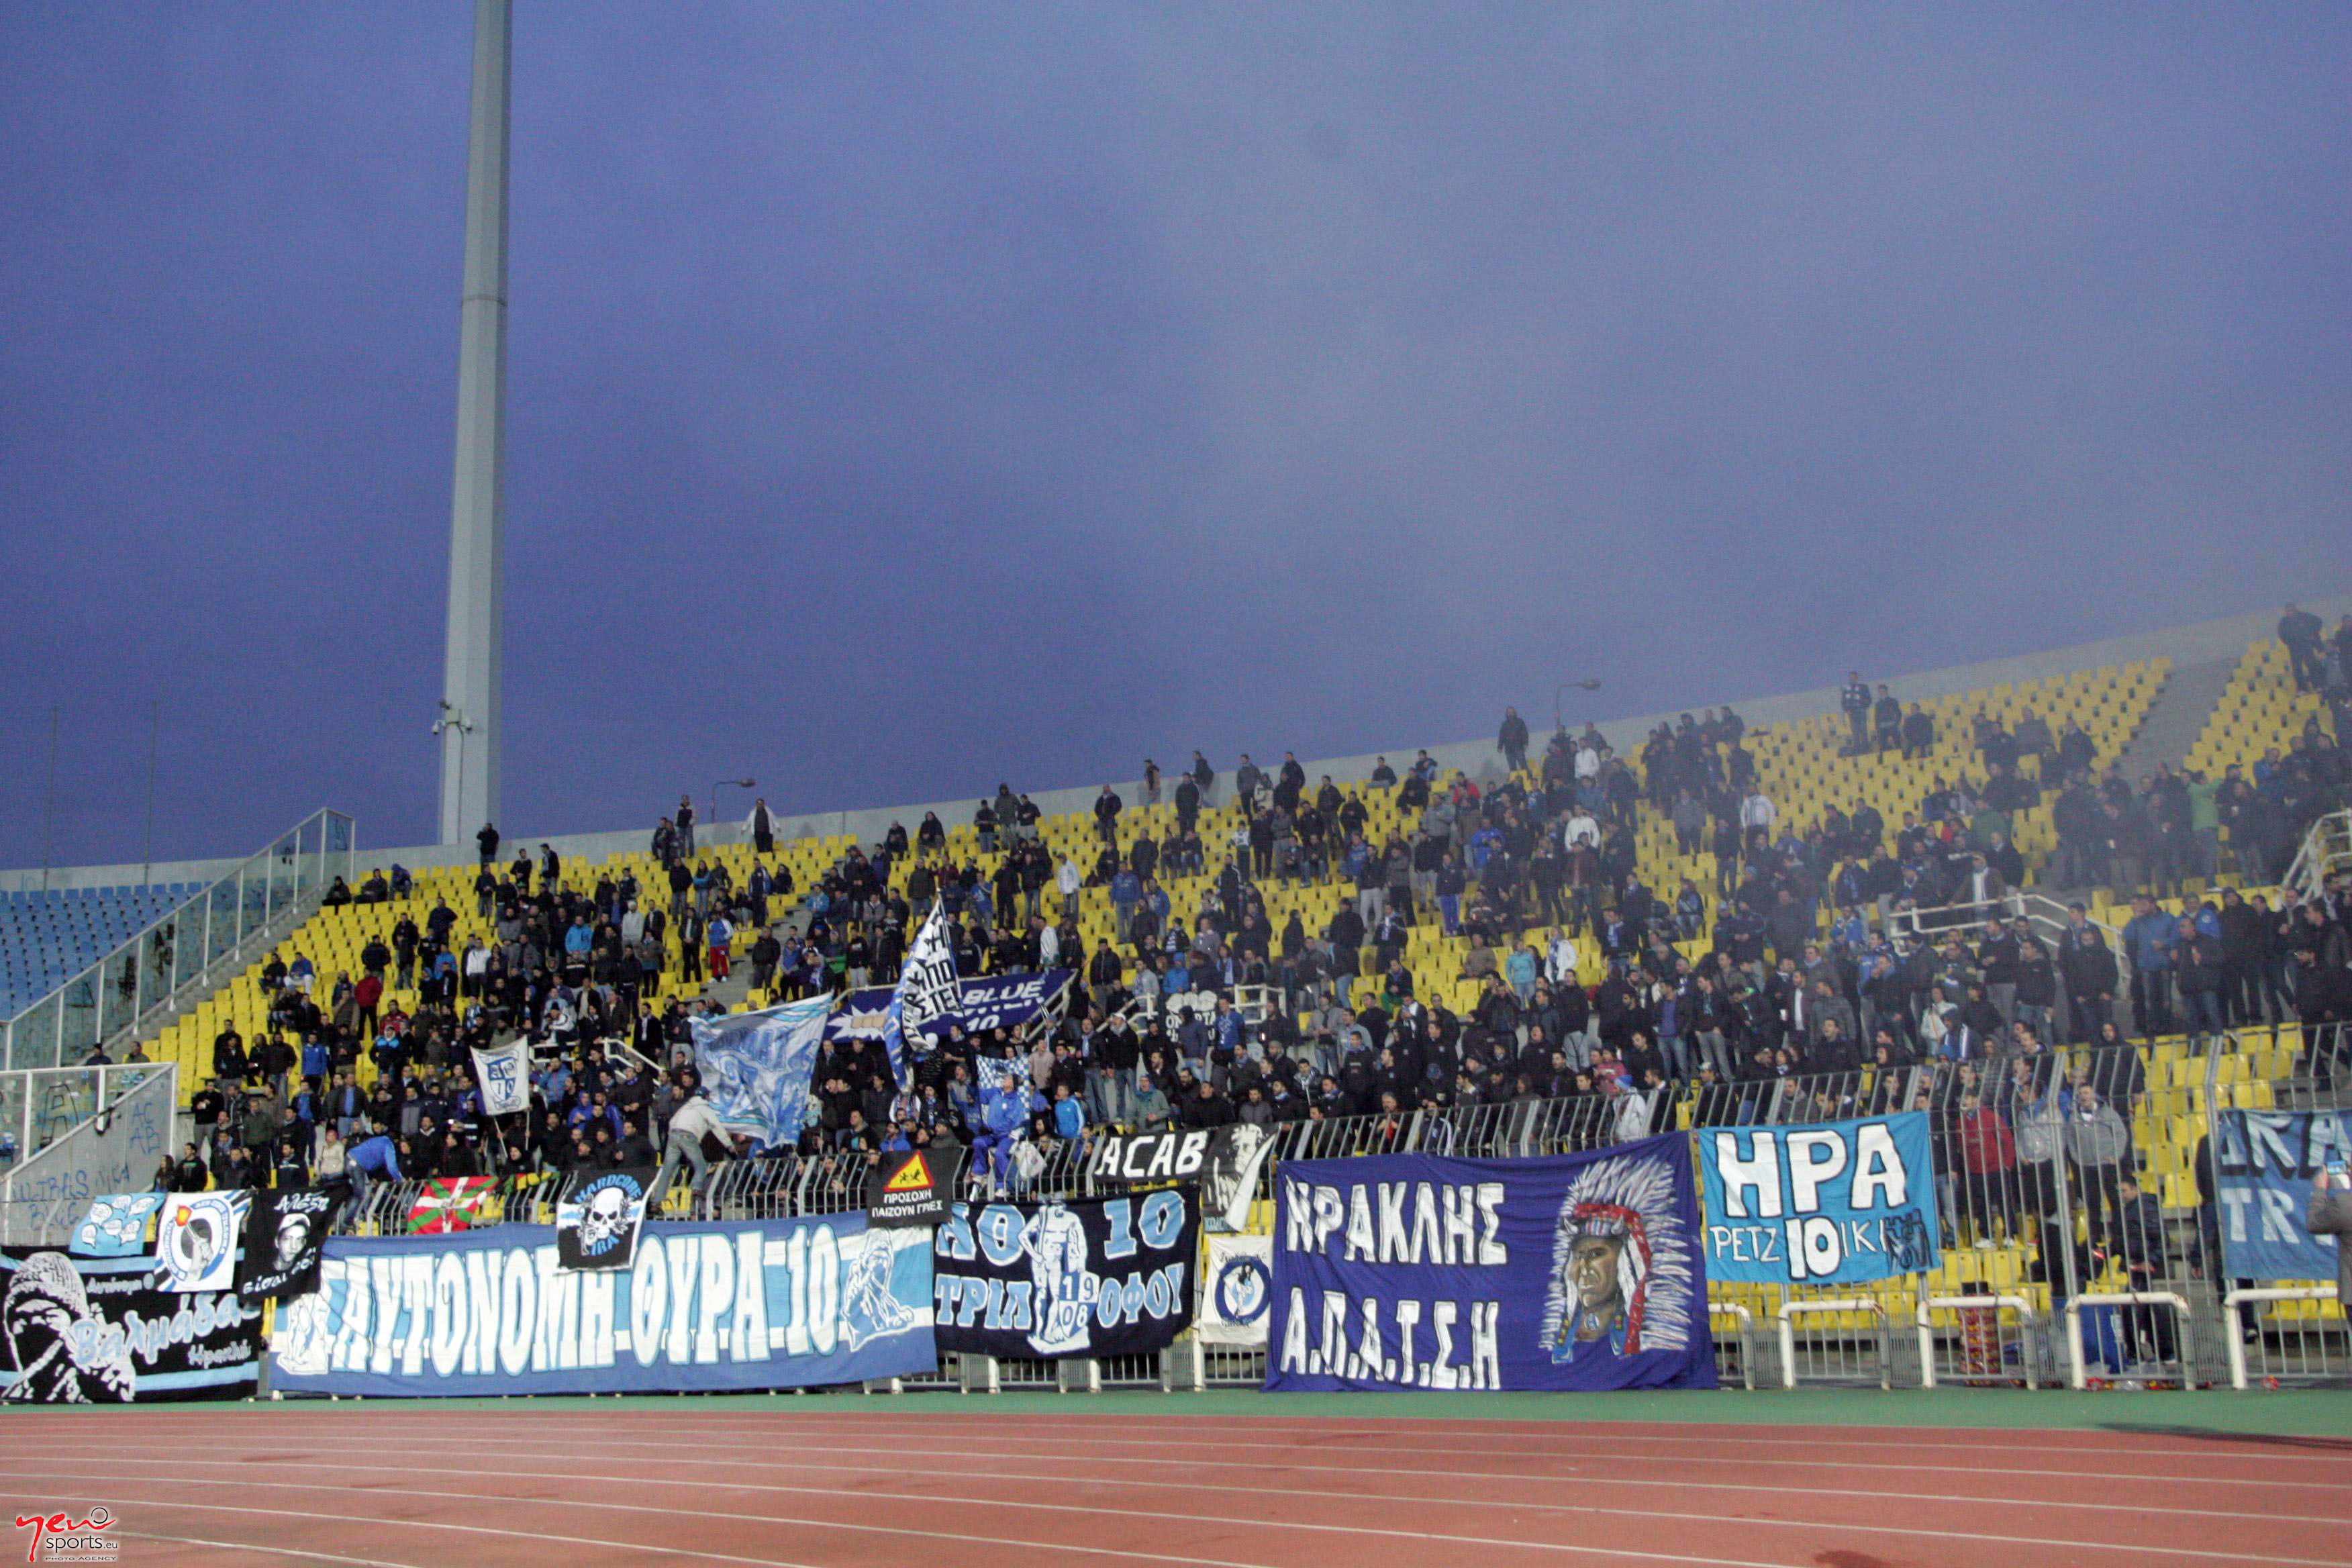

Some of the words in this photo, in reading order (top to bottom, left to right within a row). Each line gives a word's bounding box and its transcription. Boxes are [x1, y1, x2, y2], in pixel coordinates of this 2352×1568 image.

[963, 980, 1045, 1005] BLUE
[1094, 1130, 1208, 1177] ACAB
[1715, 1123, 1908, 1218] ΗΡΑ
[575, 1174, 642, 1203] HARDCORE
[872, 1205, 915, 1218] ΠΑΙΖΟΥΝ
[884, 1189, 932, 1204] ΠΡΟΣΟΧΗ
[1103, 1190, 1185, 1260] 10
[1285, 1176, 1507, 1265] ΗΡΑΚΛΗΣ
[591, 1235, 620, 1256] IRA
[1785, 1217, 1842, 1280] 10
[331, 1246, 616, 1378] ΑΥΤΟΝΟΜΗ
[630, 1229, 771, 1367] ΘΥΡΑ
[785, 1223, 840, 1356] 10
